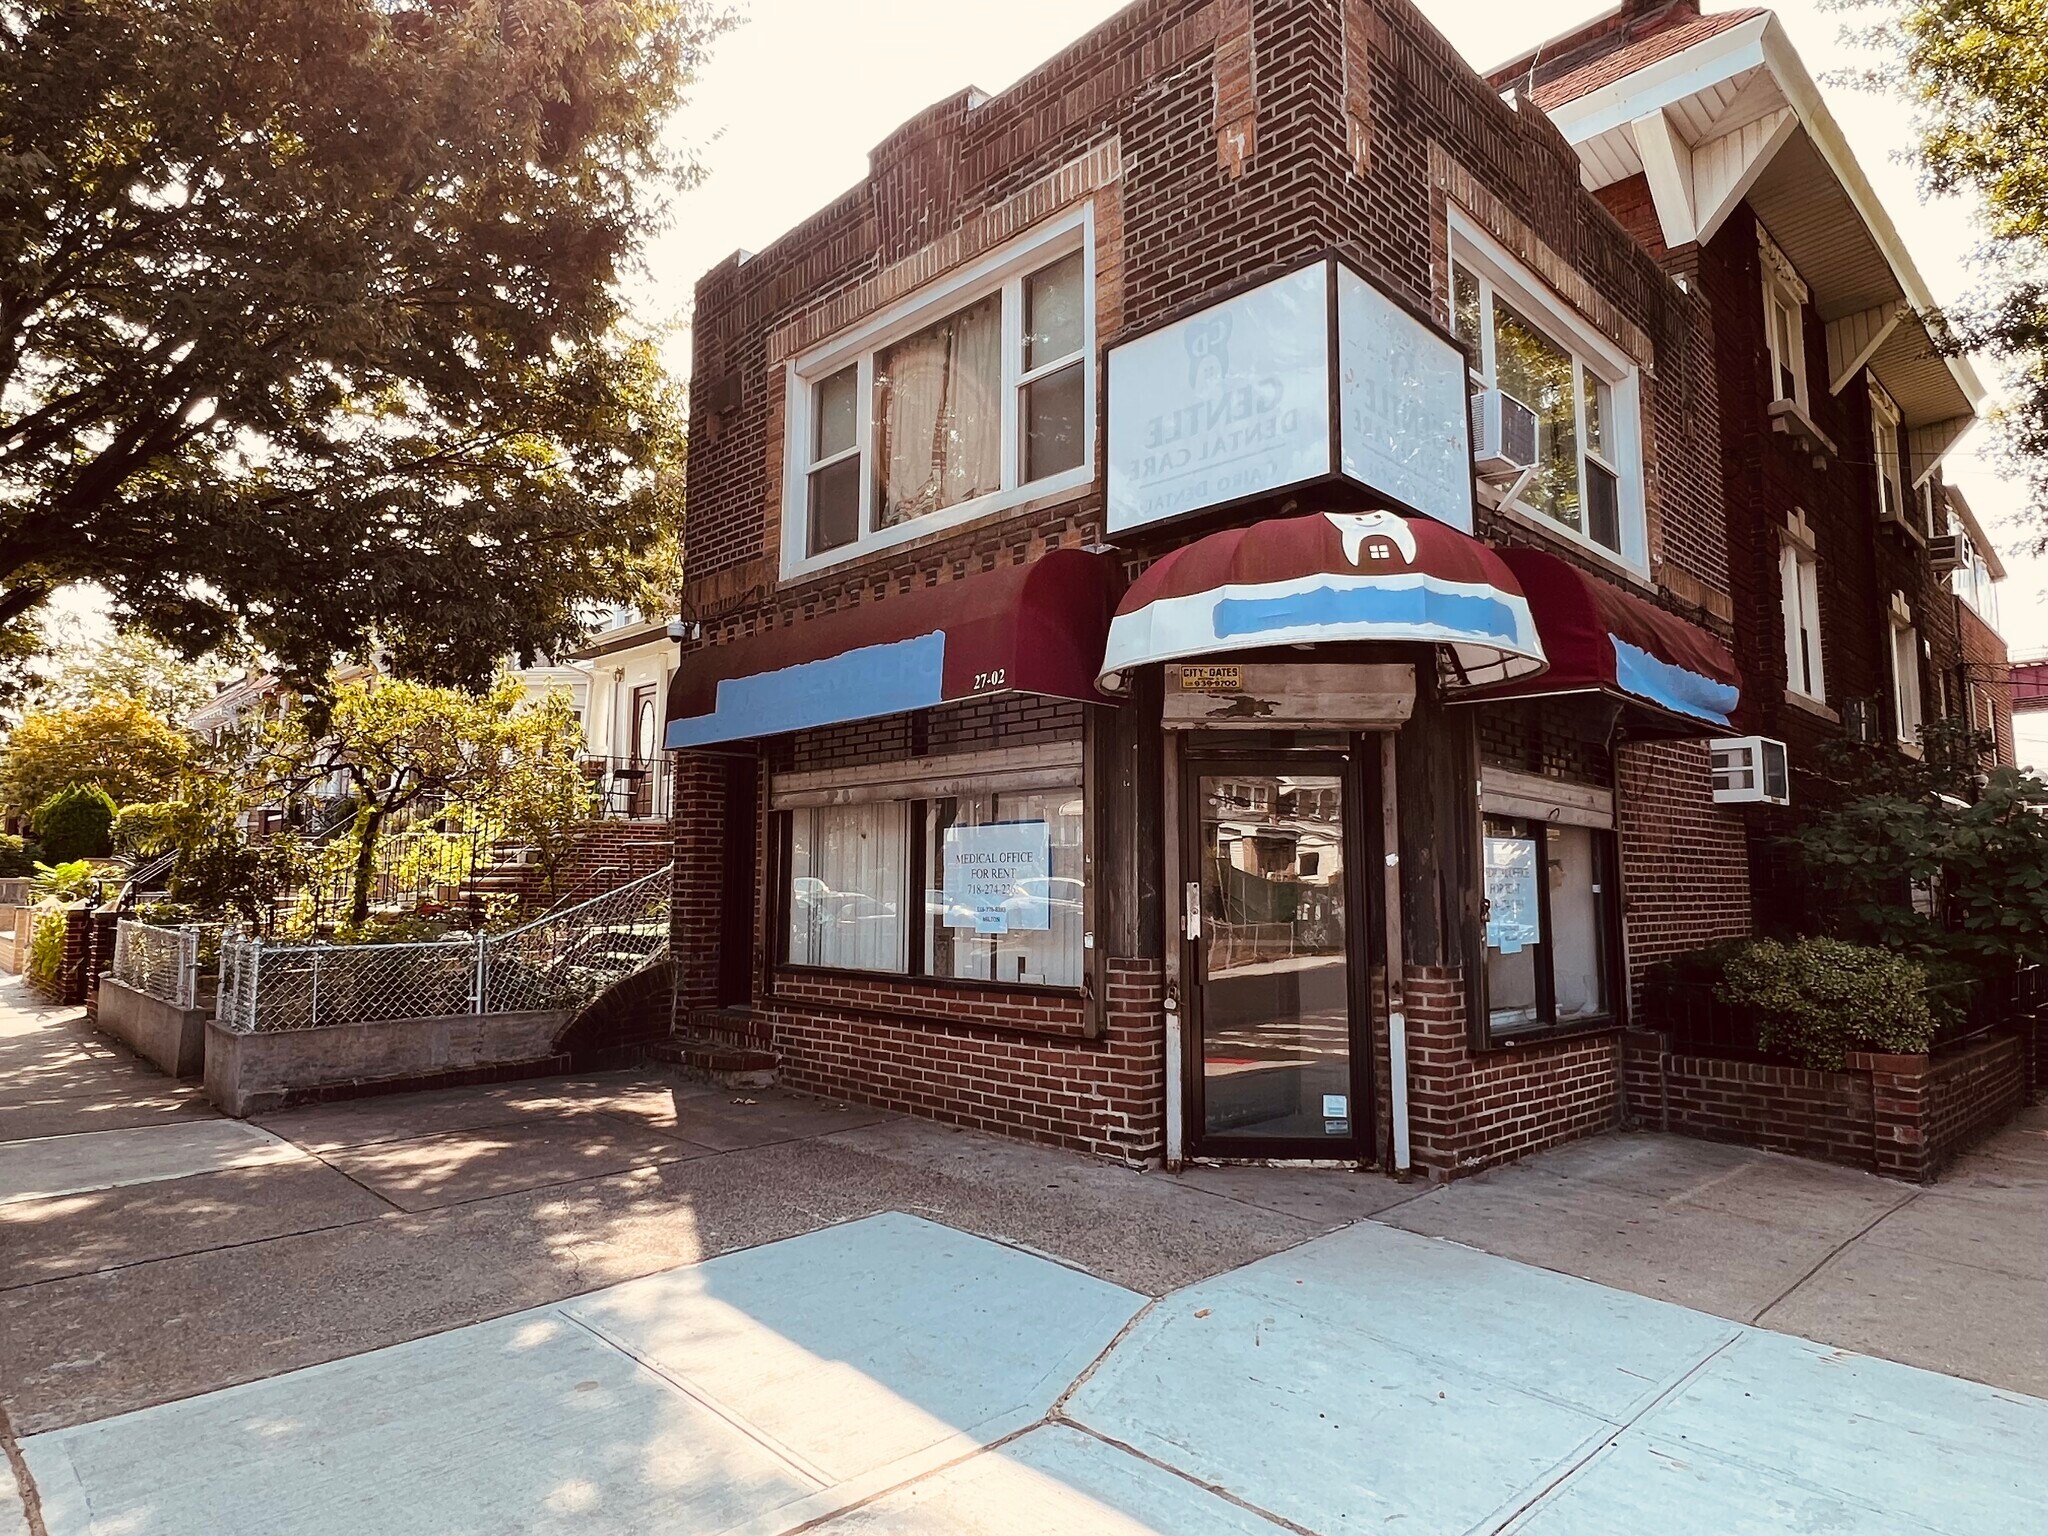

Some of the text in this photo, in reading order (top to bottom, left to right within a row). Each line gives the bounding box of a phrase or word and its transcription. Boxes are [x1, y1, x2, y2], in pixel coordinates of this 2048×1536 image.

[973, 669, 1005, 689] 27-02
[956, 851, 1033, 864] MEDICAL OFFICE
[971, 867, 1017, 879] FOR RENT
